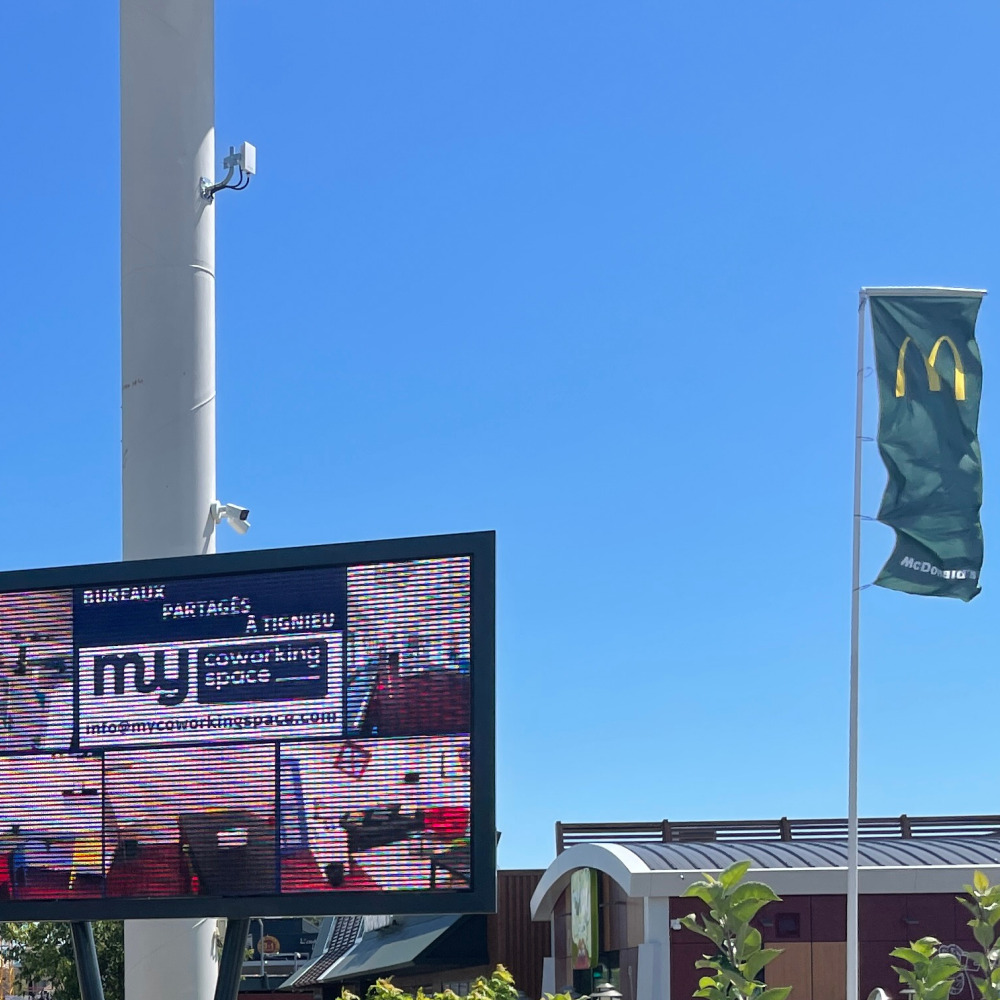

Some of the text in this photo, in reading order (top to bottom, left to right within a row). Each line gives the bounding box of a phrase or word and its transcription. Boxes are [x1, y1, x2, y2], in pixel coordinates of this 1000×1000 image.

[83, 584, 166, 604] BUREAUX
[262, 612, 335, 632] TIGNIEU
[204, 644, 321, 668] coworking
[93, 649, 190, 706] my
[204, 668, 271, 690] space
